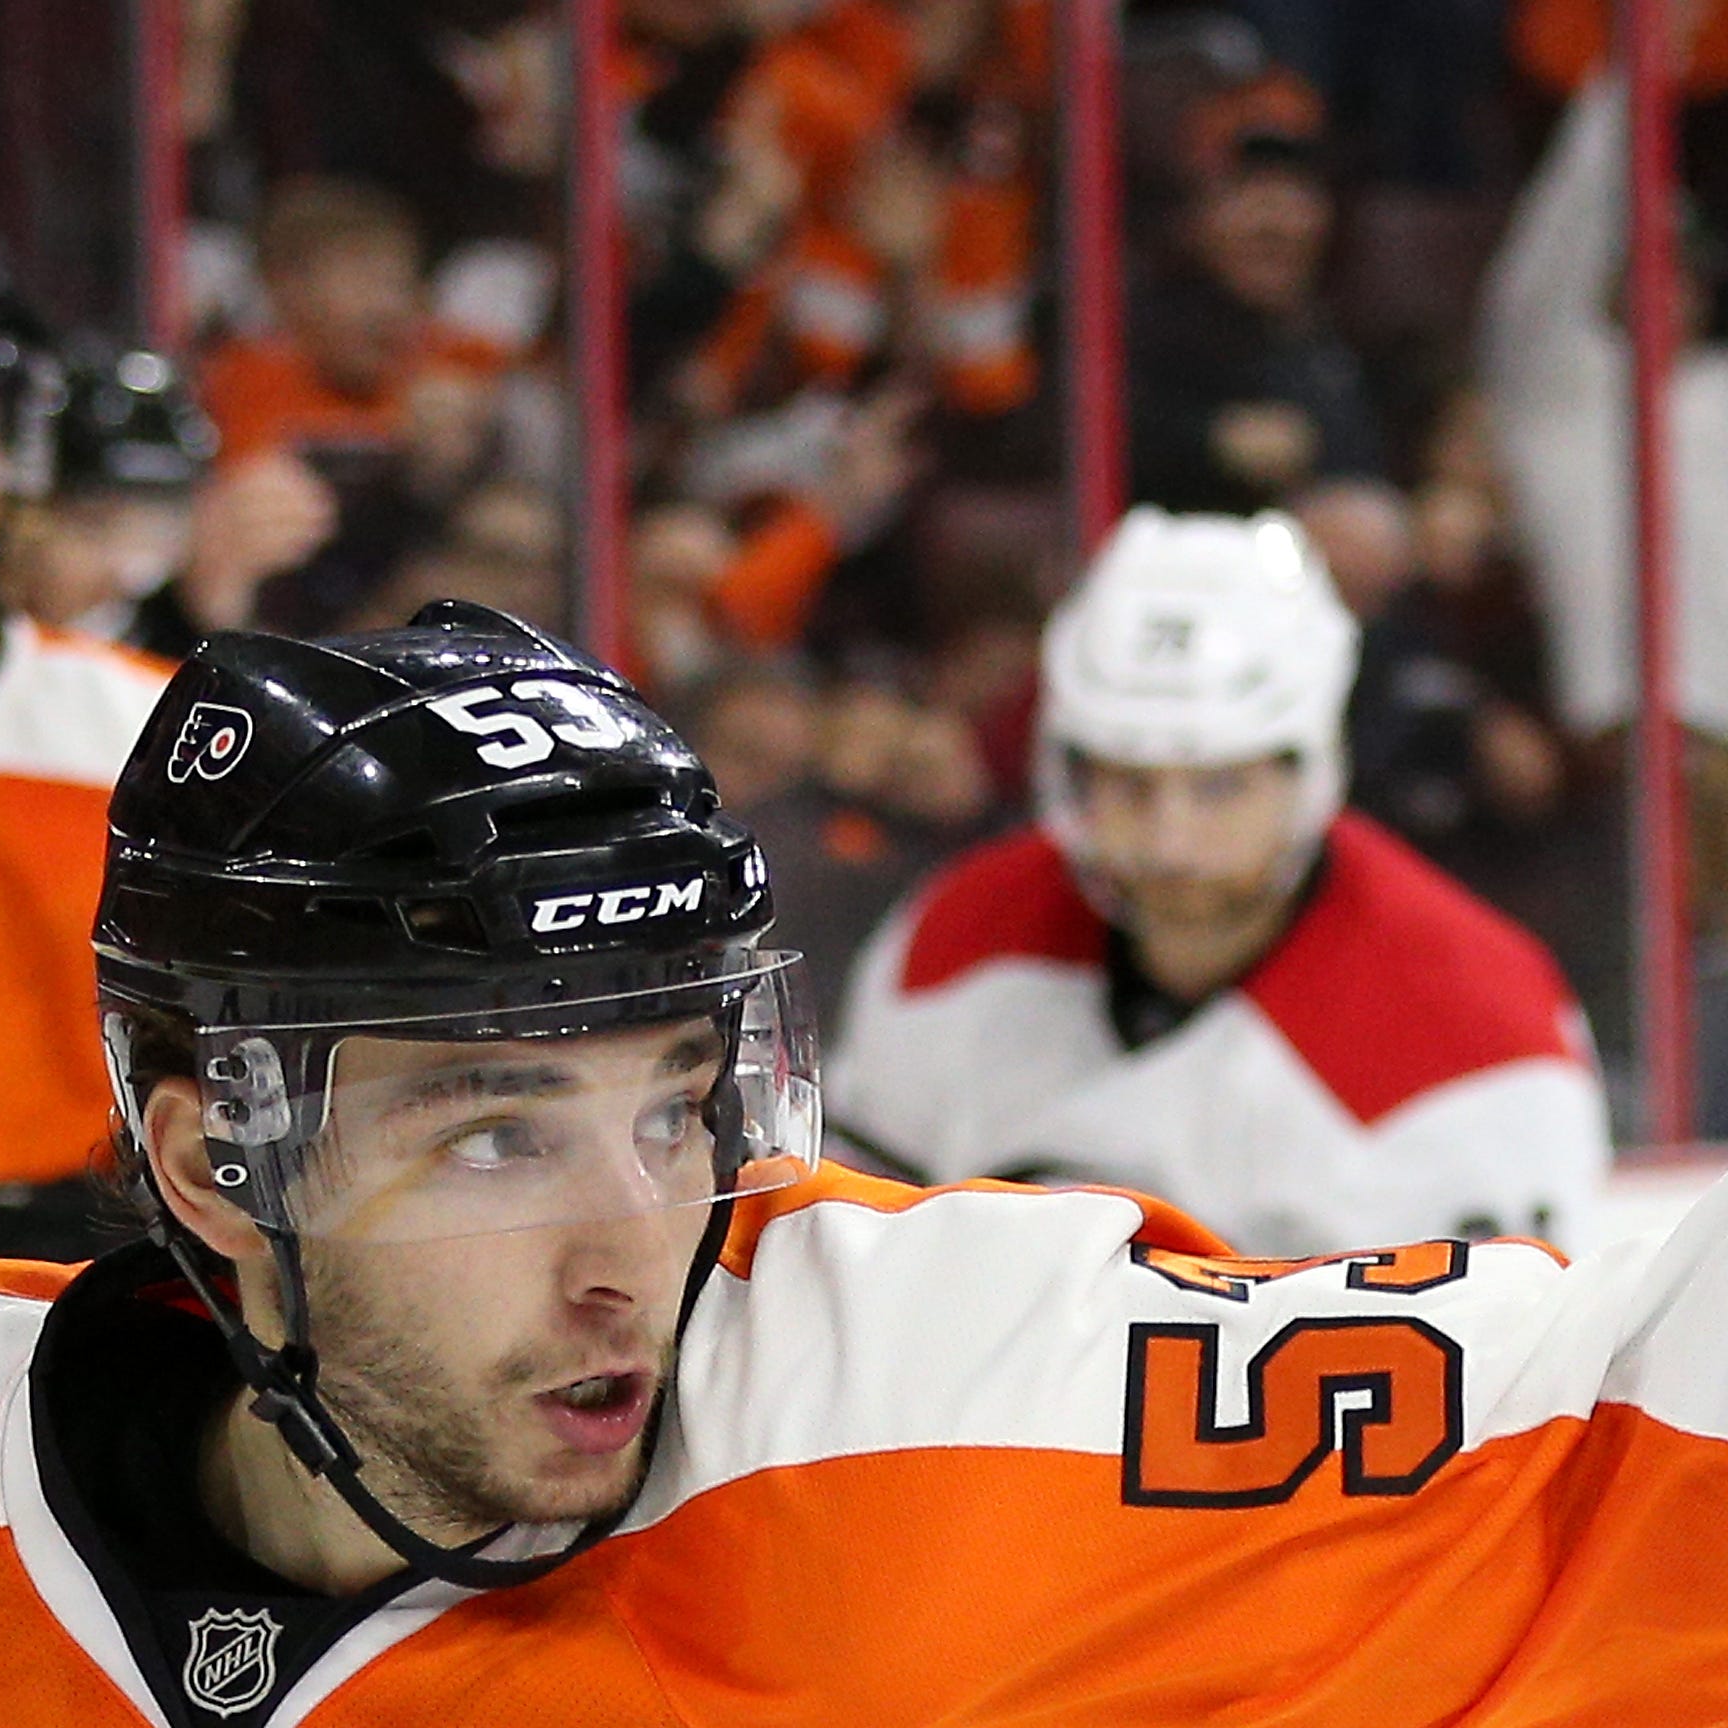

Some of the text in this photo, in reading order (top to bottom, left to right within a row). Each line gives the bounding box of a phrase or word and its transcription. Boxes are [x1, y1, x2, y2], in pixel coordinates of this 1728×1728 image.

[425, 679, 625, 770] 53
[531, 878, 703, 933] CCM
[203, 1635, 260, 1690] NHL
